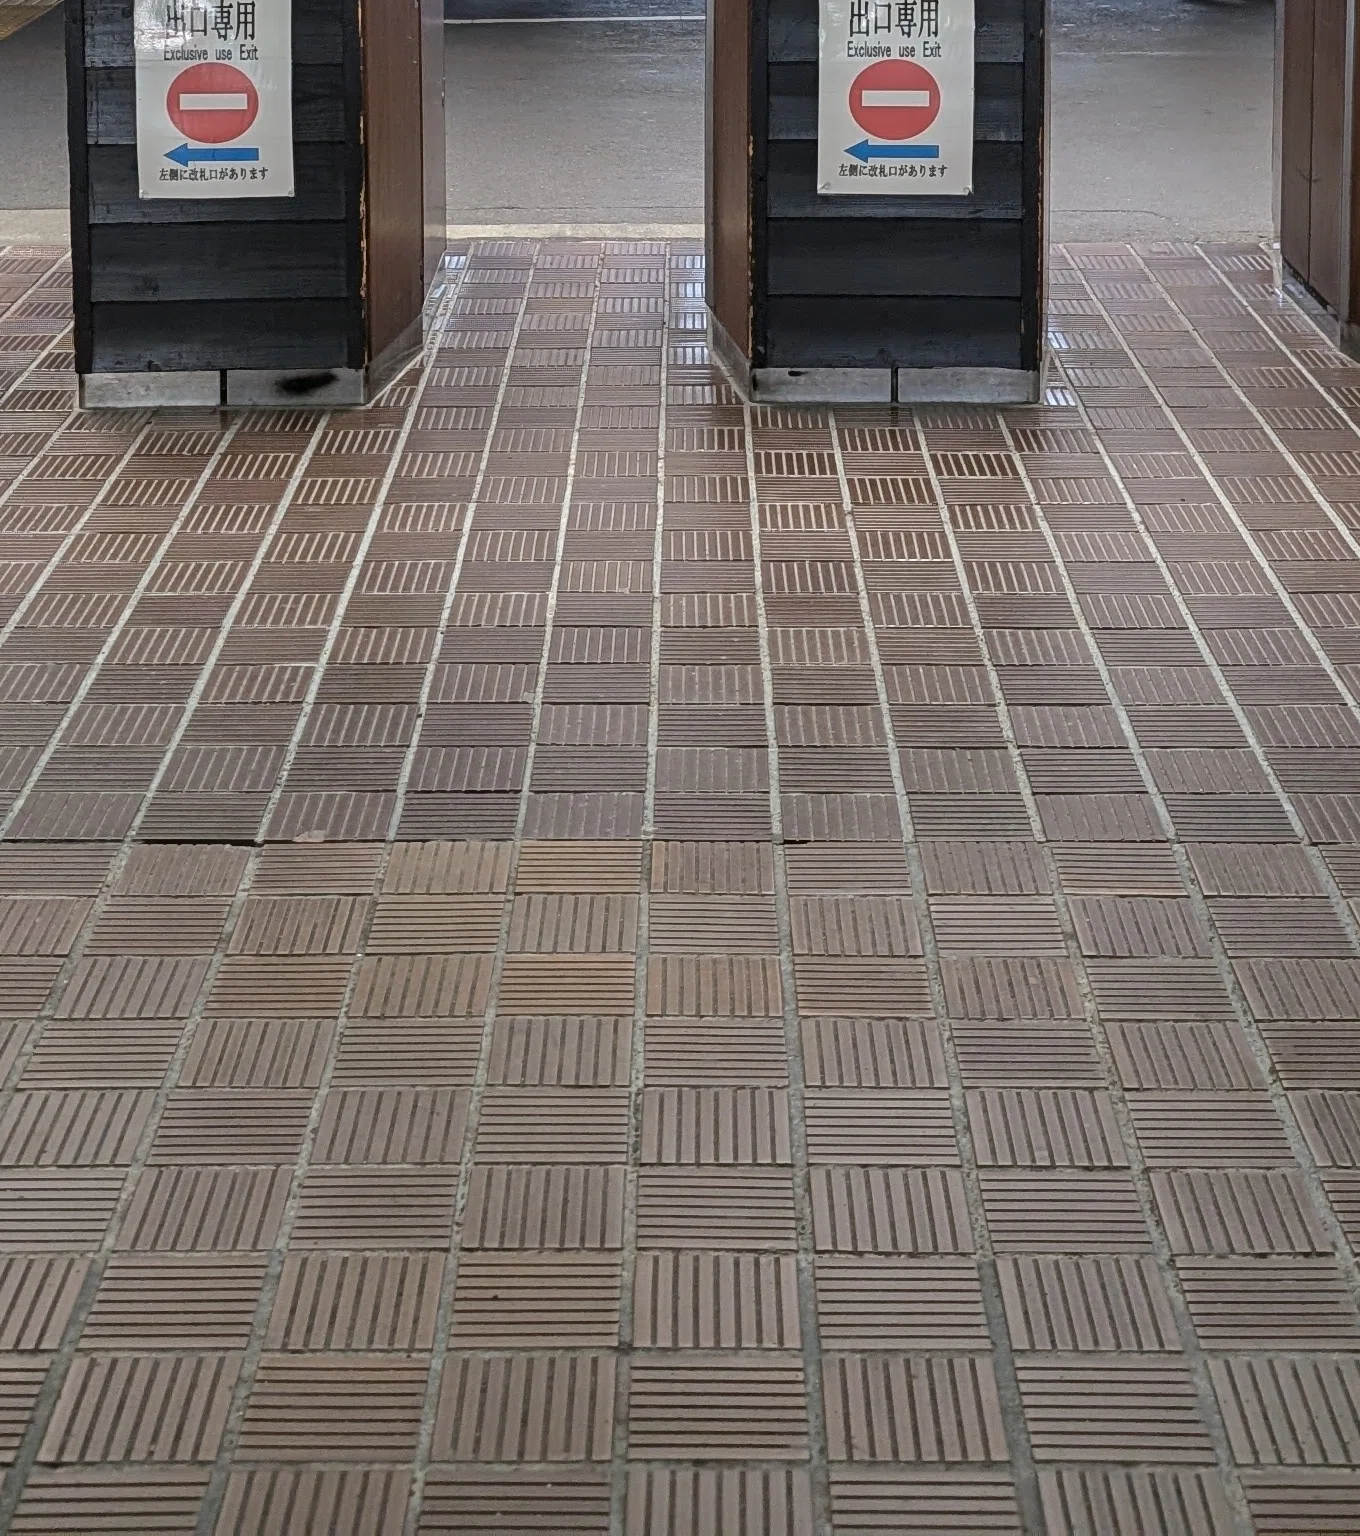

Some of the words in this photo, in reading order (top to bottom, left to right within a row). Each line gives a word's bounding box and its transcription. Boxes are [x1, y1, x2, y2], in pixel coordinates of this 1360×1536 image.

[166, 0, 255, 41] 出口専用
[164, 44, 208, 61] Exclusive
[215, 48, 232, 61] use
[240, 44, 258, 61] Exit
[847, 41, 891, 57] Exclusive
[899, 45, 915, 57] use
[923, 41, 941, 57] Exit
[159, 167, 268, 181] 左側に改札口があります
[839, 164, 947, 177] 左側に改札口があります
